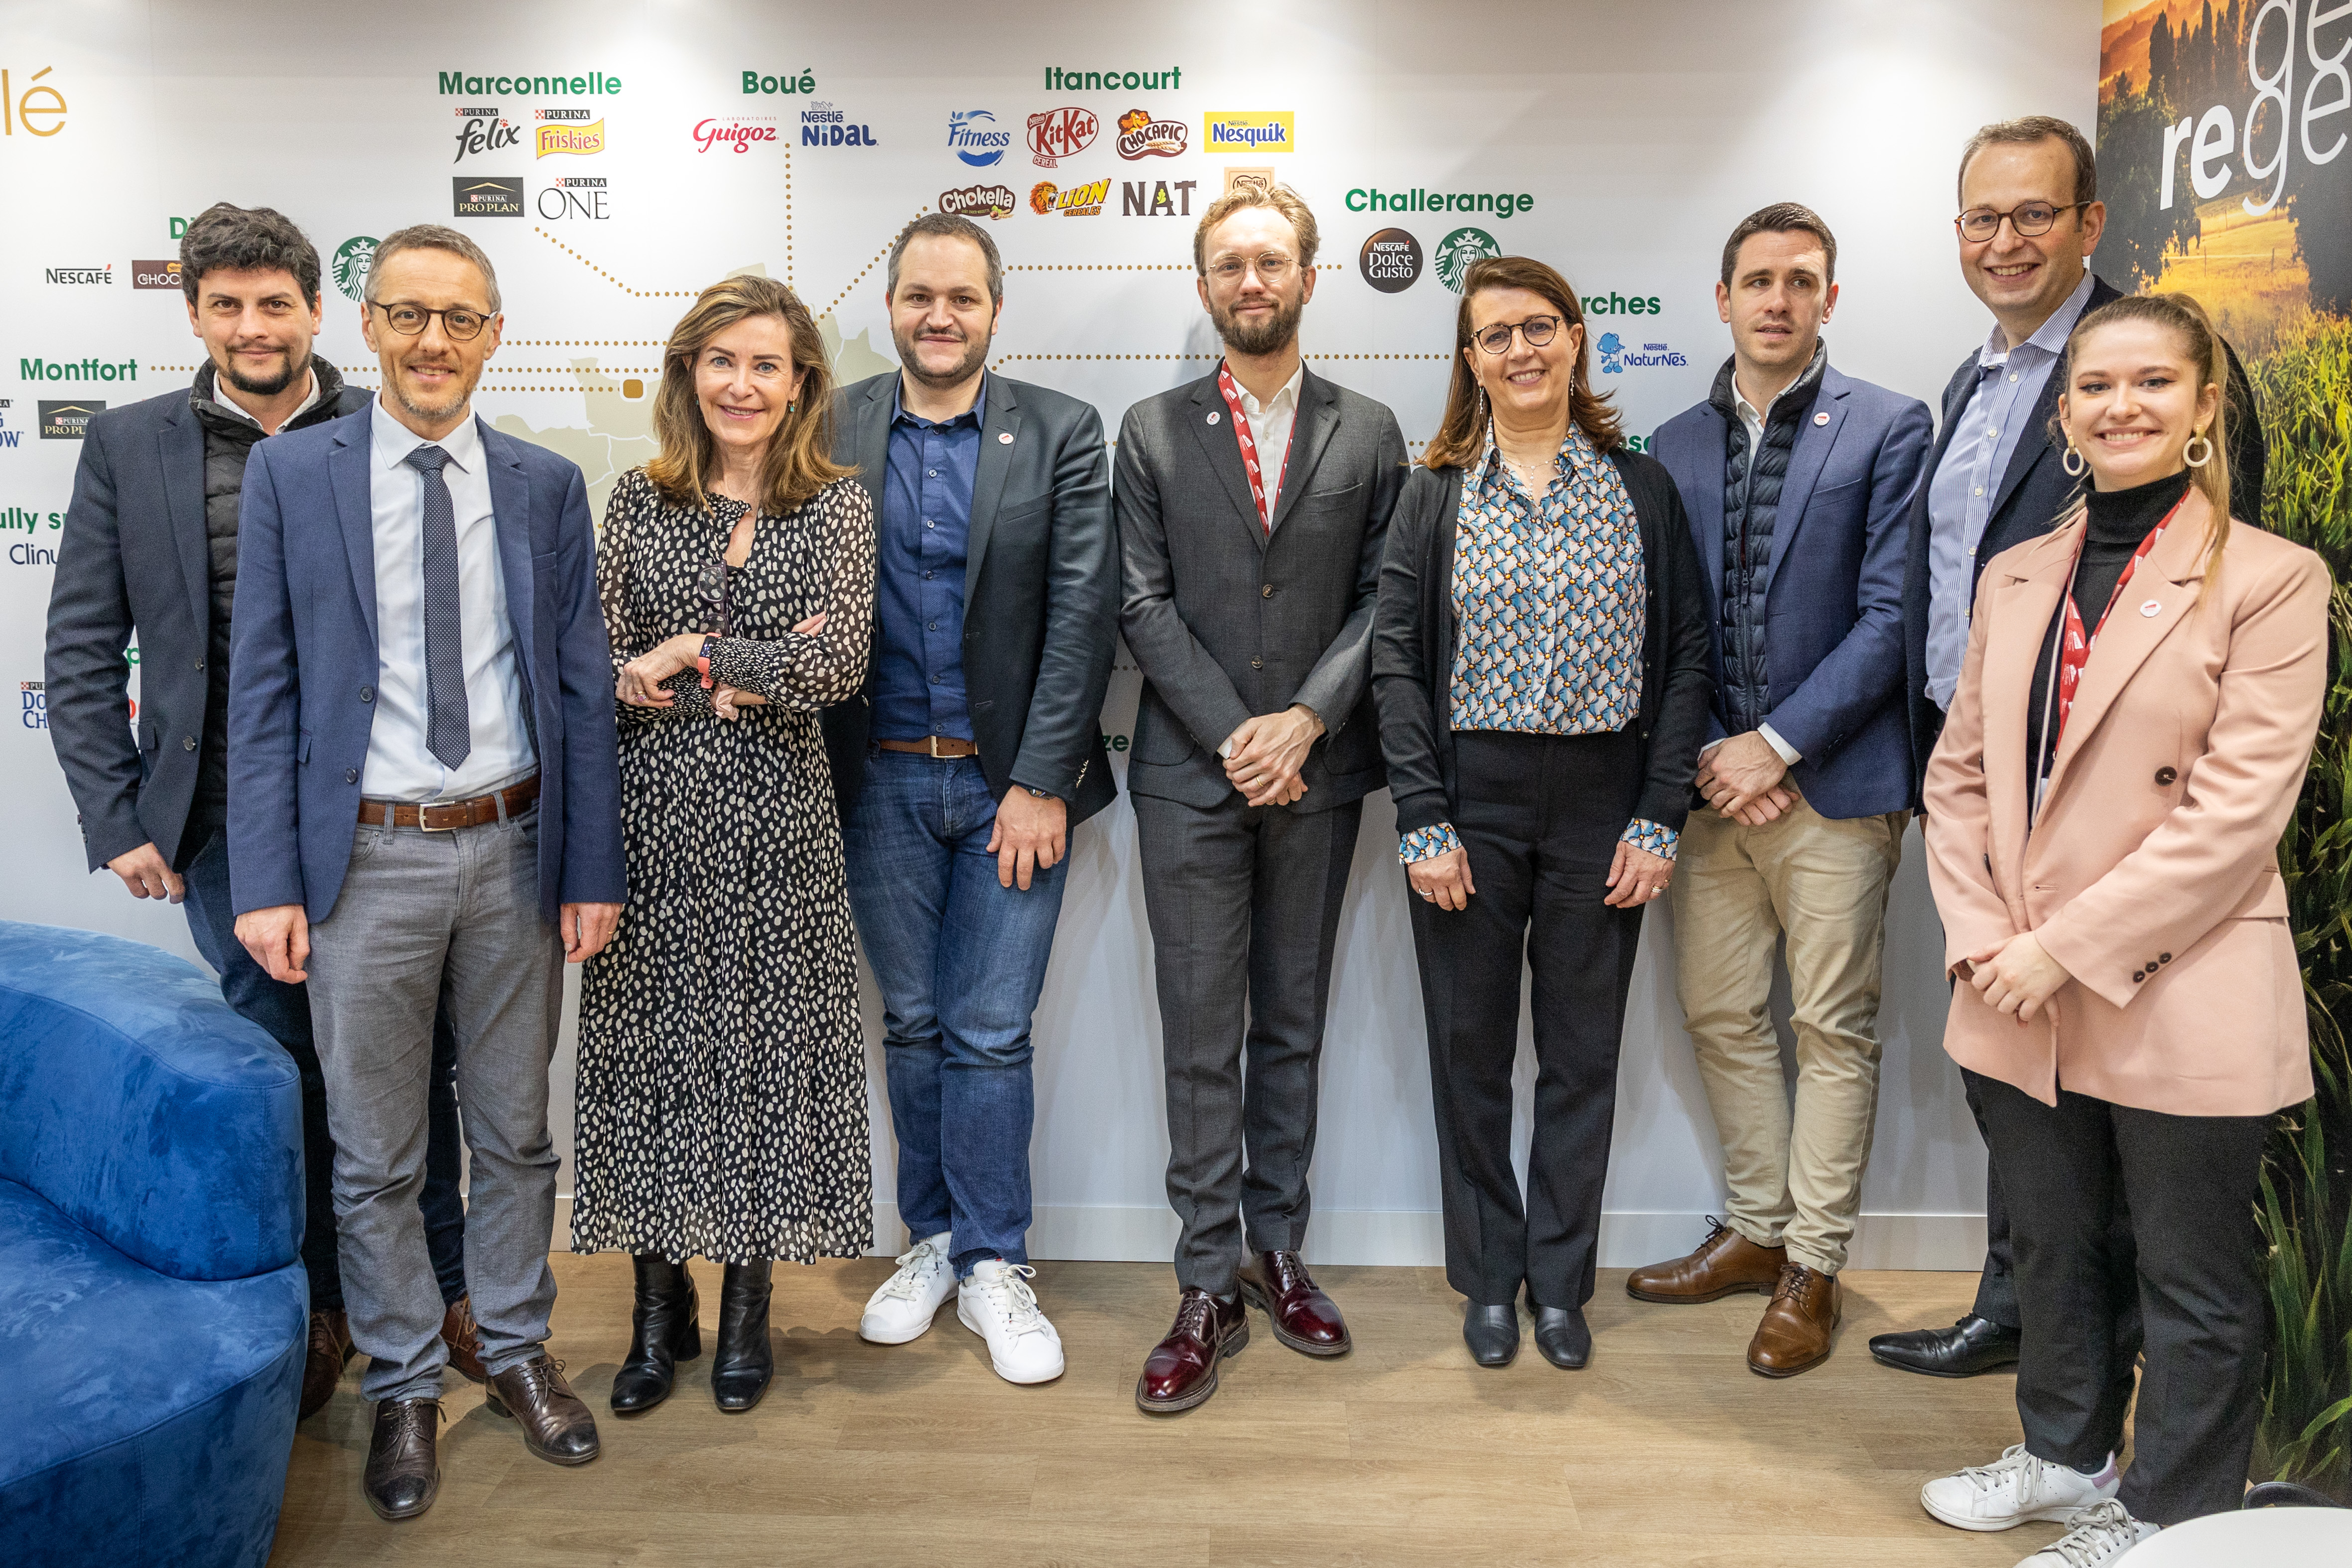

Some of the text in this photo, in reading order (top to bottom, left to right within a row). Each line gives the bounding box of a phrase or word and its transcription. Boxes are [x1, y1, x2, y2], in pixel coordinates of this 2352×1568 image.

[439, 72, 622, 95] Marconnelle
[742, 68, 815, 94] Boué
[1046, 66, 1181, 90] Itancourt
[1, 65, 67, 137] lé
[546, 110, 589, 119] PURINA
[801, 111, 843, 124] Nestlé
[453, 118, 521, 164] felix
[541, 130, 600, 150] Friskies
[693, 119, 777, 153] Guigoz
[948, 122, 1010, 146] Fitness
[1120, 124, 1183, 154] CHOCAPIC
[1213, 123, 1286, 146] Nesquik
[1034, 155, 1057, 168] CEREAL
[459, 203, 519, 212] PRO PLAN
[538, 188, 610, 220] ONE
[942, 187, 1014, 213] Chokella
[1122, 181, 1196, 216] NAT
[1345, 189, 1534, 218] Challerange
[1064, 206, 1101, 217] CEREALES
[169, 217, 195, 239] D
[1373, 240, 1409, 252] NESCAFÉ
[1368, 252, 1413, 266] Dolce
[46, 264, 112, 284] NESCAFÉ
[137, 273, 182, 285] CHOC
[1369, 265, 1413, 278] Gusto
[20, 358, 137, 381] Montfort
[1624, 353, 1686, 366] NaturNes
[45, 425, 69, 435] PRO
[48, 513, 67, 529] s
